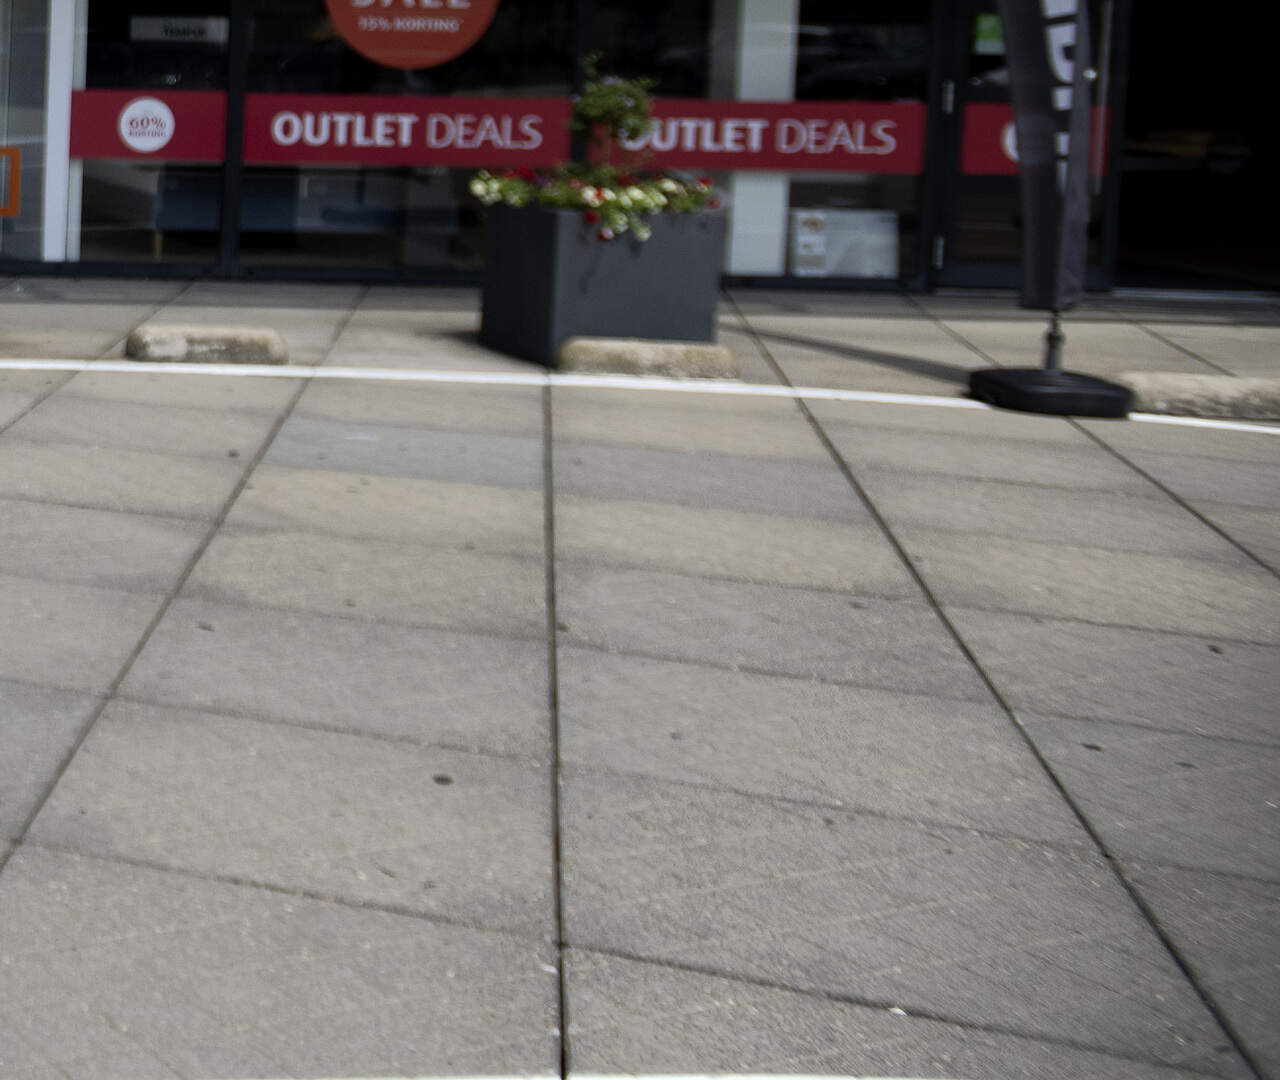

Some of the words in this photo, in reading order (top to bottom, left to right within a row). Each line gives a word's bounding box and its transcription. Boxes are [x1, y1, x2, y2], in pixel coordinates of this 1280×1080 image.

[272, 112, 418, 147] OUTLET
[426, 114, 544, 150] DEALS
[776, 119, 897, 155] DEALS
